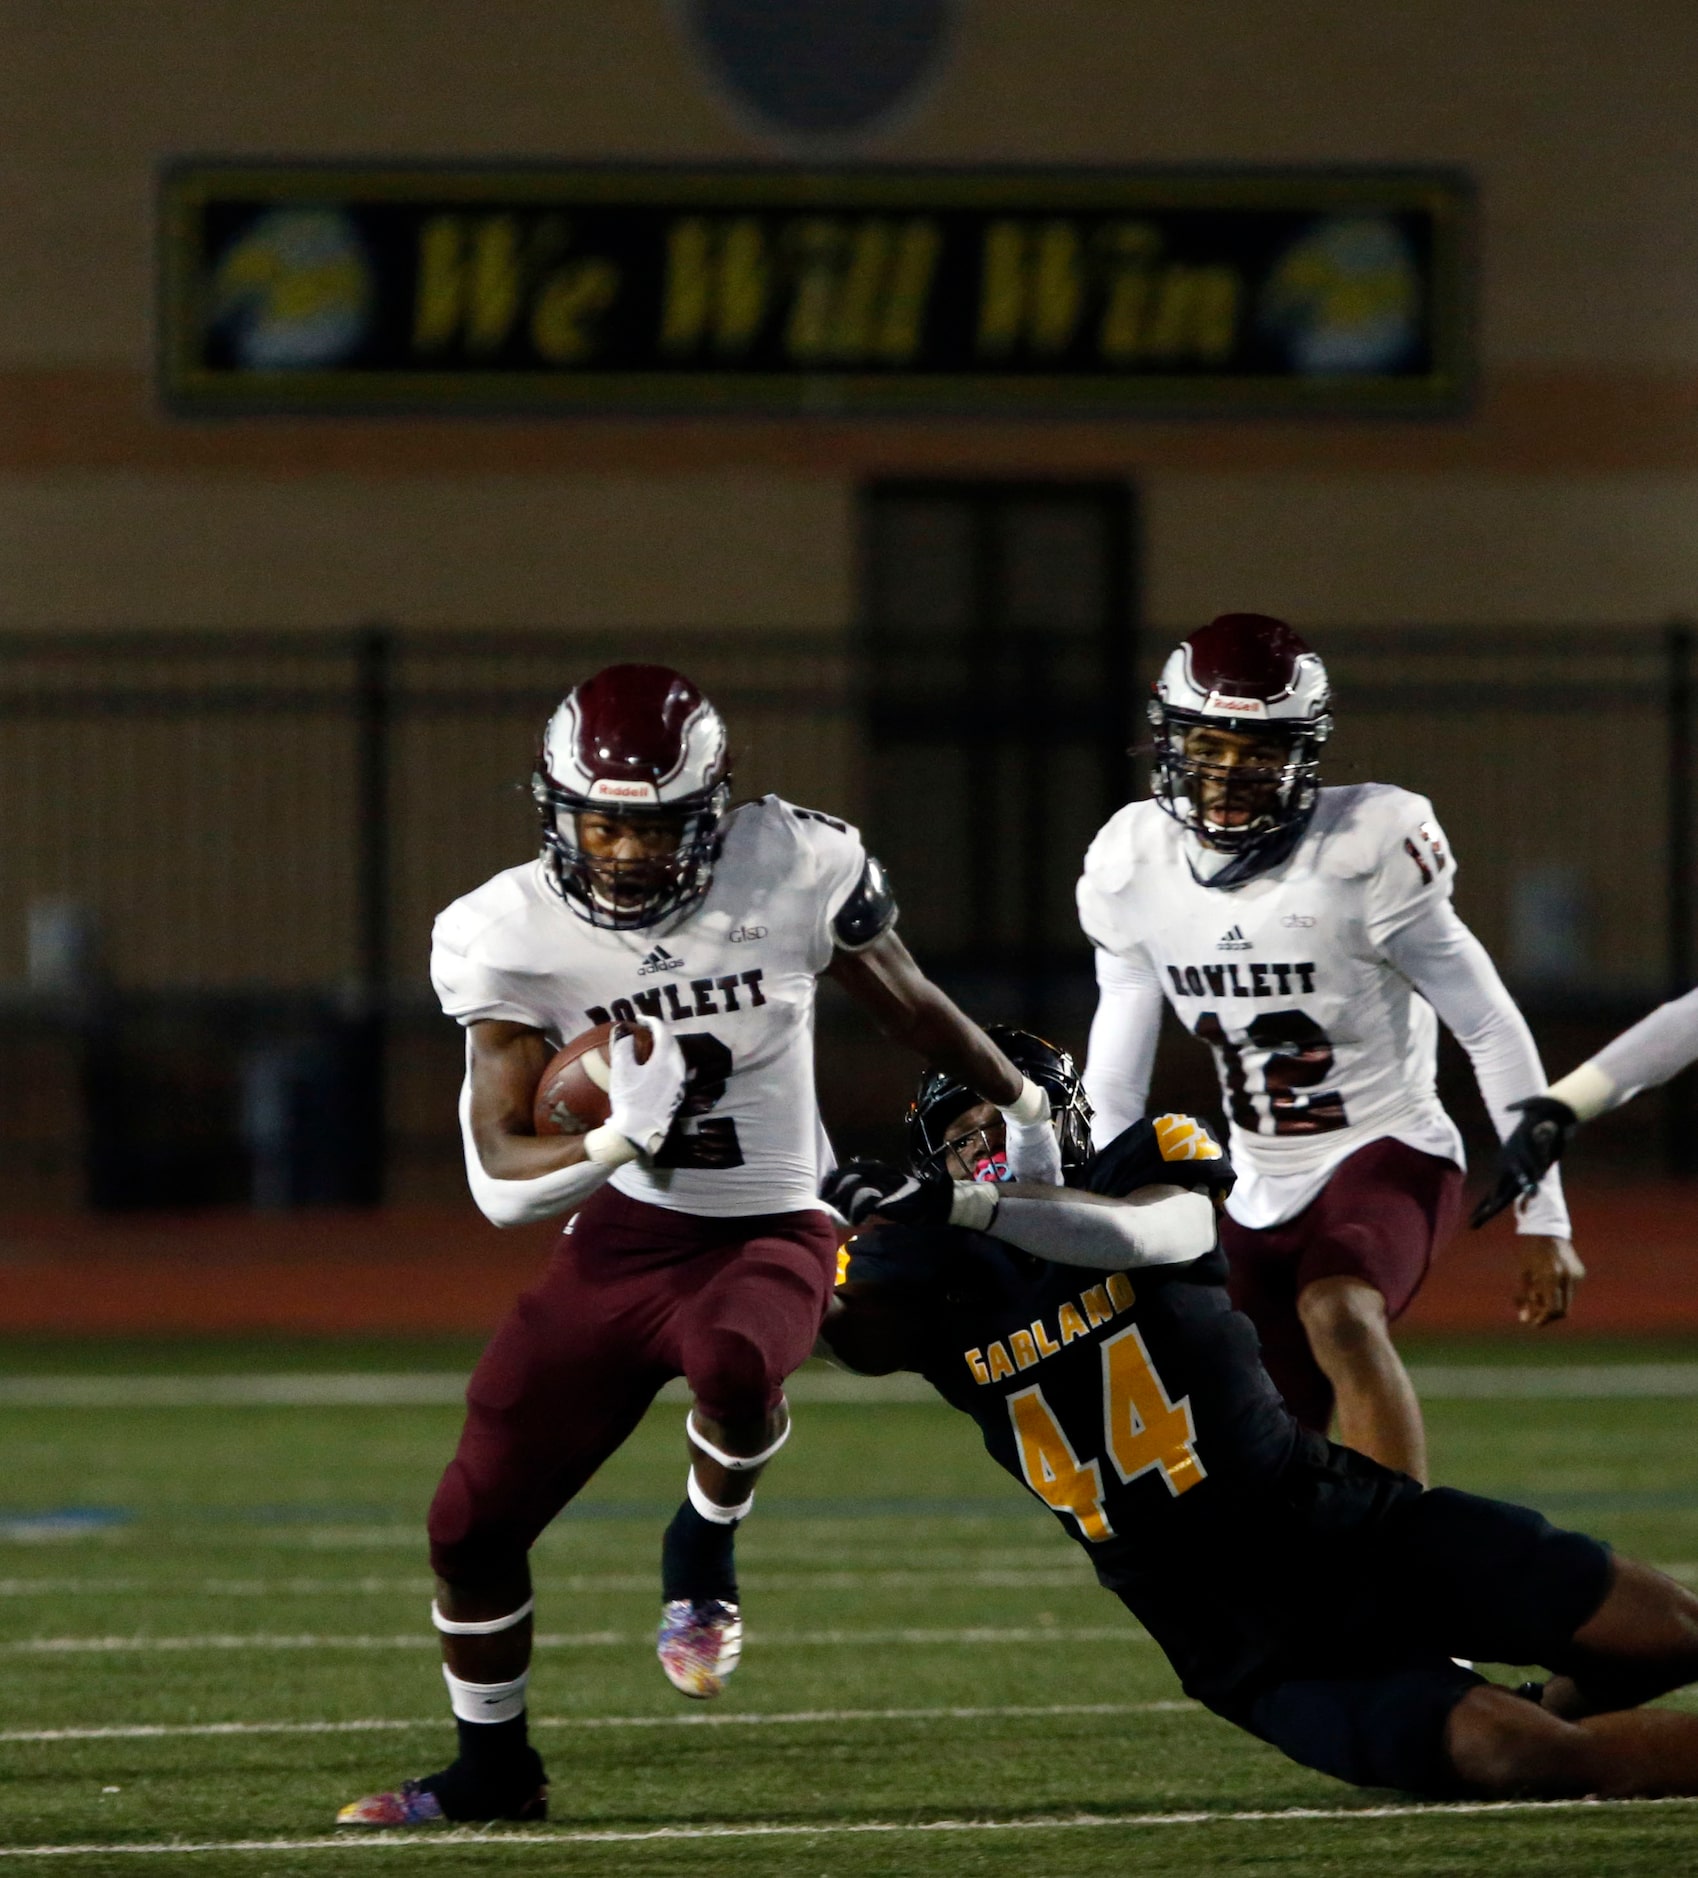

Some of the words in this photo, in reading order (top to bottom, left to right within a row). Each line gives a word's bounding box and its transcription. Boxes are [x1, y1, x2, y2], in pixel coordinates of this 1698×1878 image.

[637, 958, 685, 976] adidas
[654, 1032, 745, 1170] 2
[1194, 1009, 1350, 1137] 12
[964, 1273, 1136, 1386] GARLAND
[1005, 1322, 1208, 1543] 44
